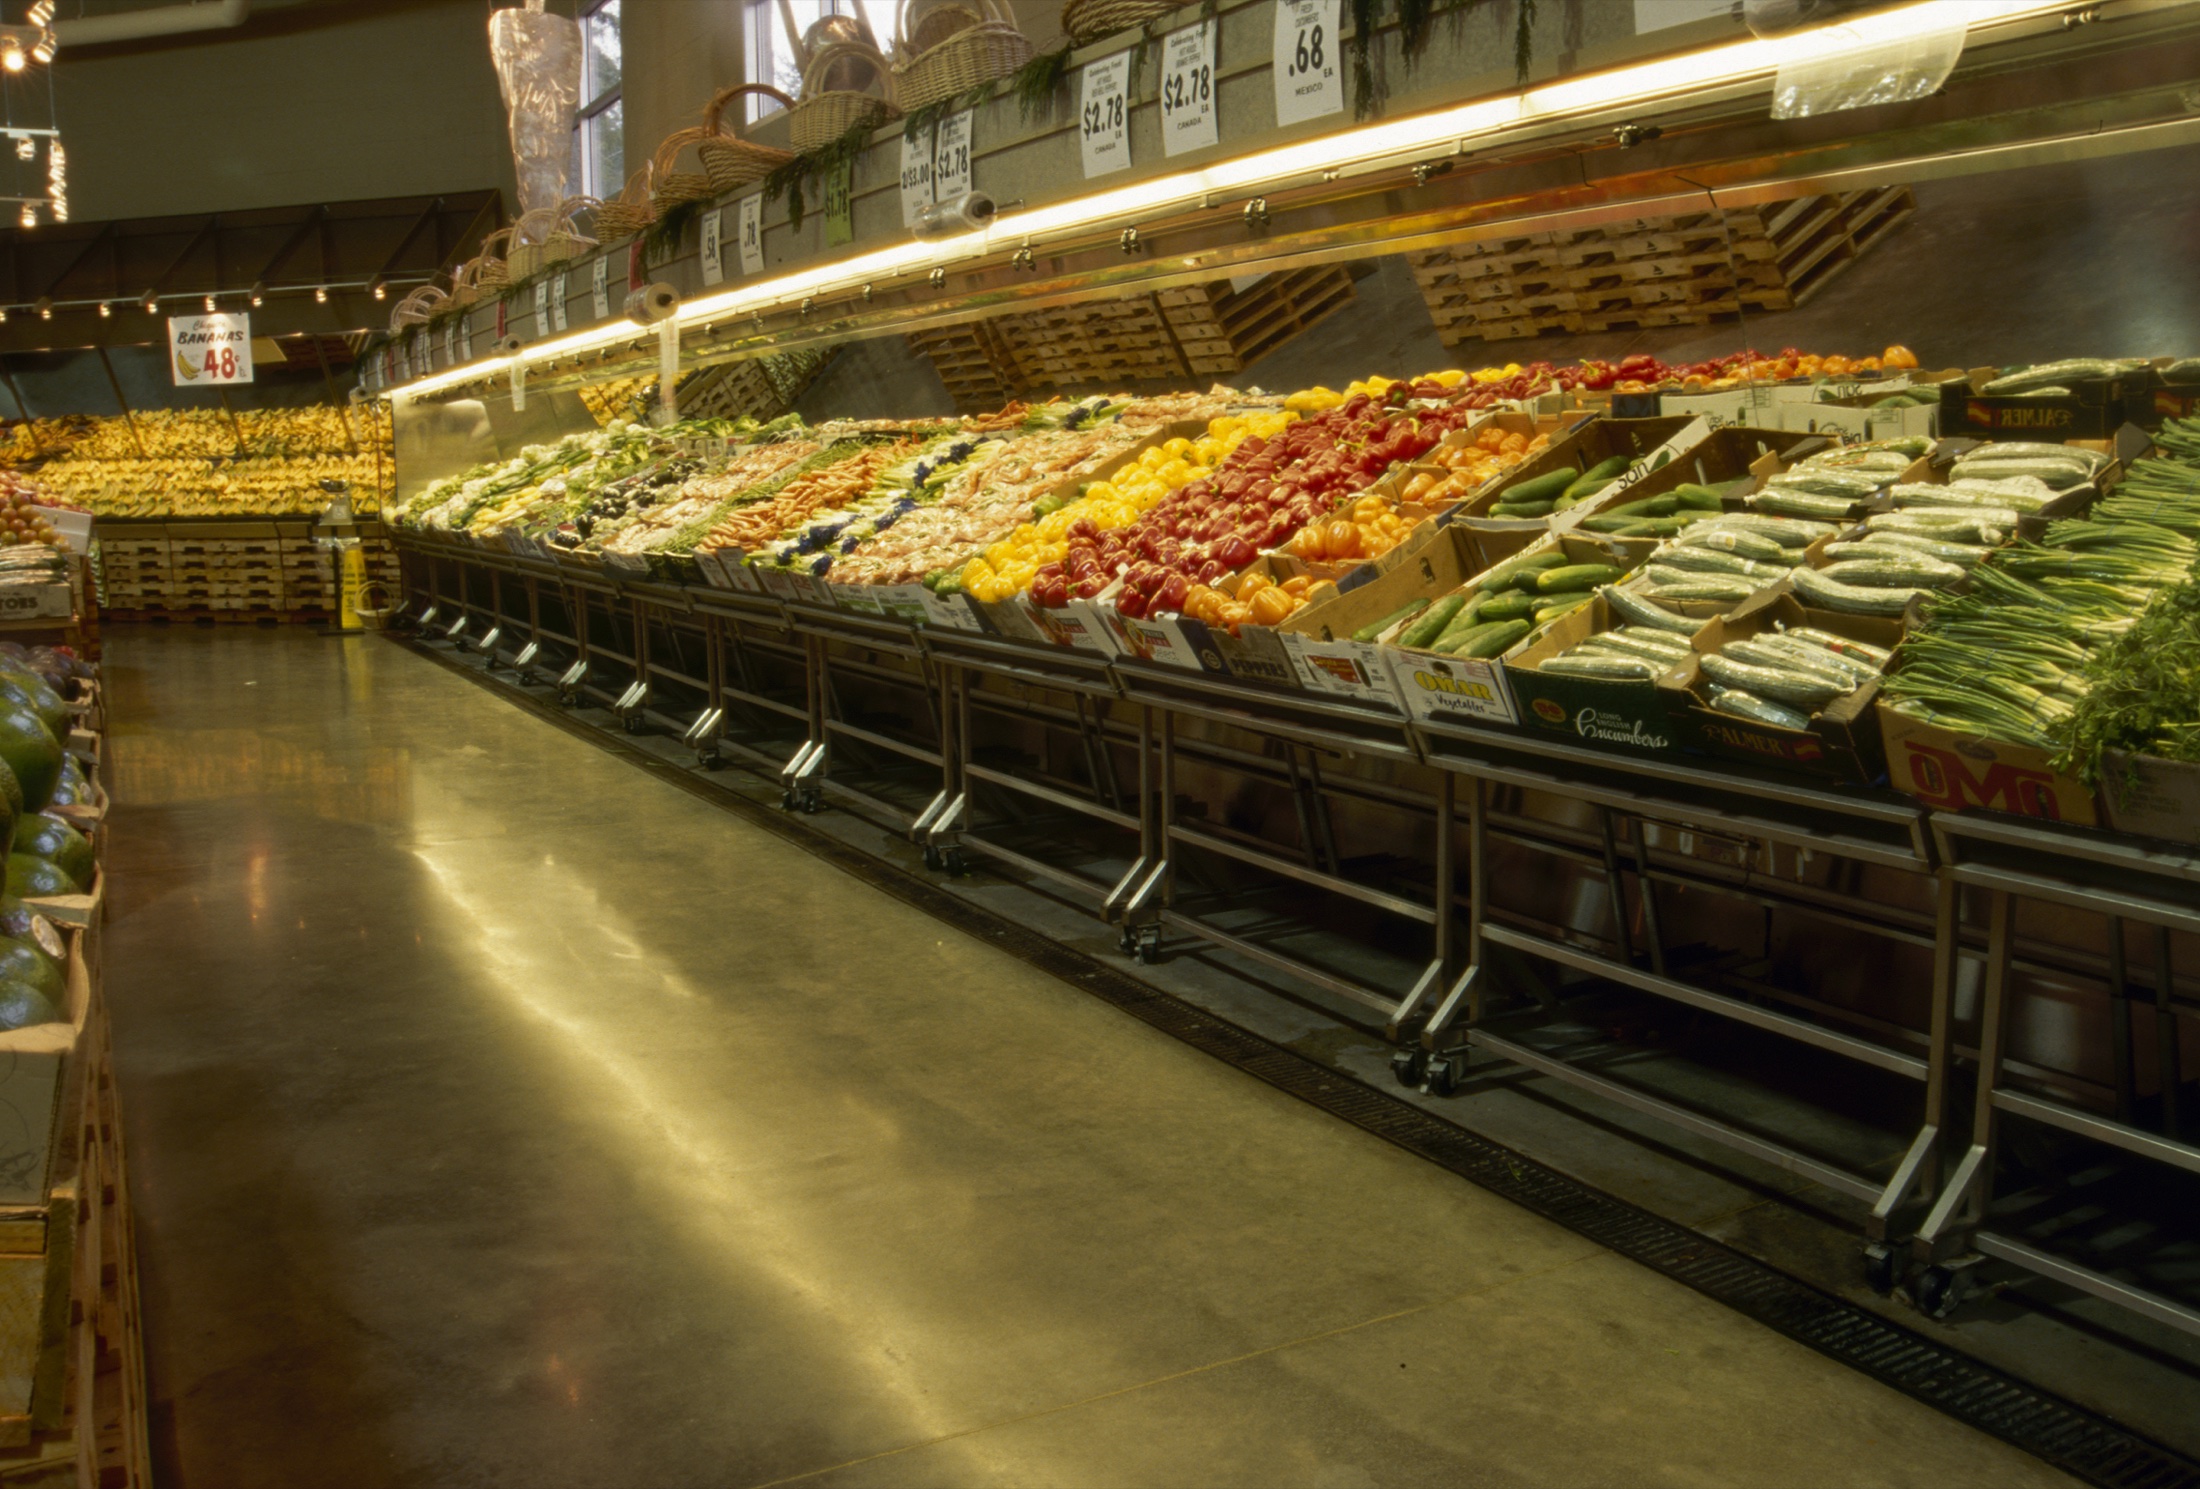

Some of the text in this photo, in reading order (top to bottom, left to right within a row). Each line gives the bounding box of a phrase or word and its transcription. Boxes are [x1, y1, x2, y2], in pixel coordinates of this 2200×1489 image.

[1289, 24, 1333, 78] .68 EA
[1164, 64, 1210, 116] $2.78 EA
[1295, 82, 1323, 97] MEXICO
[1083, 93, 1123, 141] $2.78 EA
[1177, 116, 1202, 130] CANADA
[1094, 142, 1116, 155] CANADA
[938, 144, 968, 184] $2.78
[177, 330, 244, 345] BANANAS
[1229, 657, 1289, 679] PEPPERS
[1414, 670, 1495, 701] OMAR
[1435, 694, 1485, 713] Vegetables
[1596, 718, 1631, 730] ENGLISH
[1597, 711, 1621, 722] LONG
[1573, 707, 1668, 749] Cucumbers
